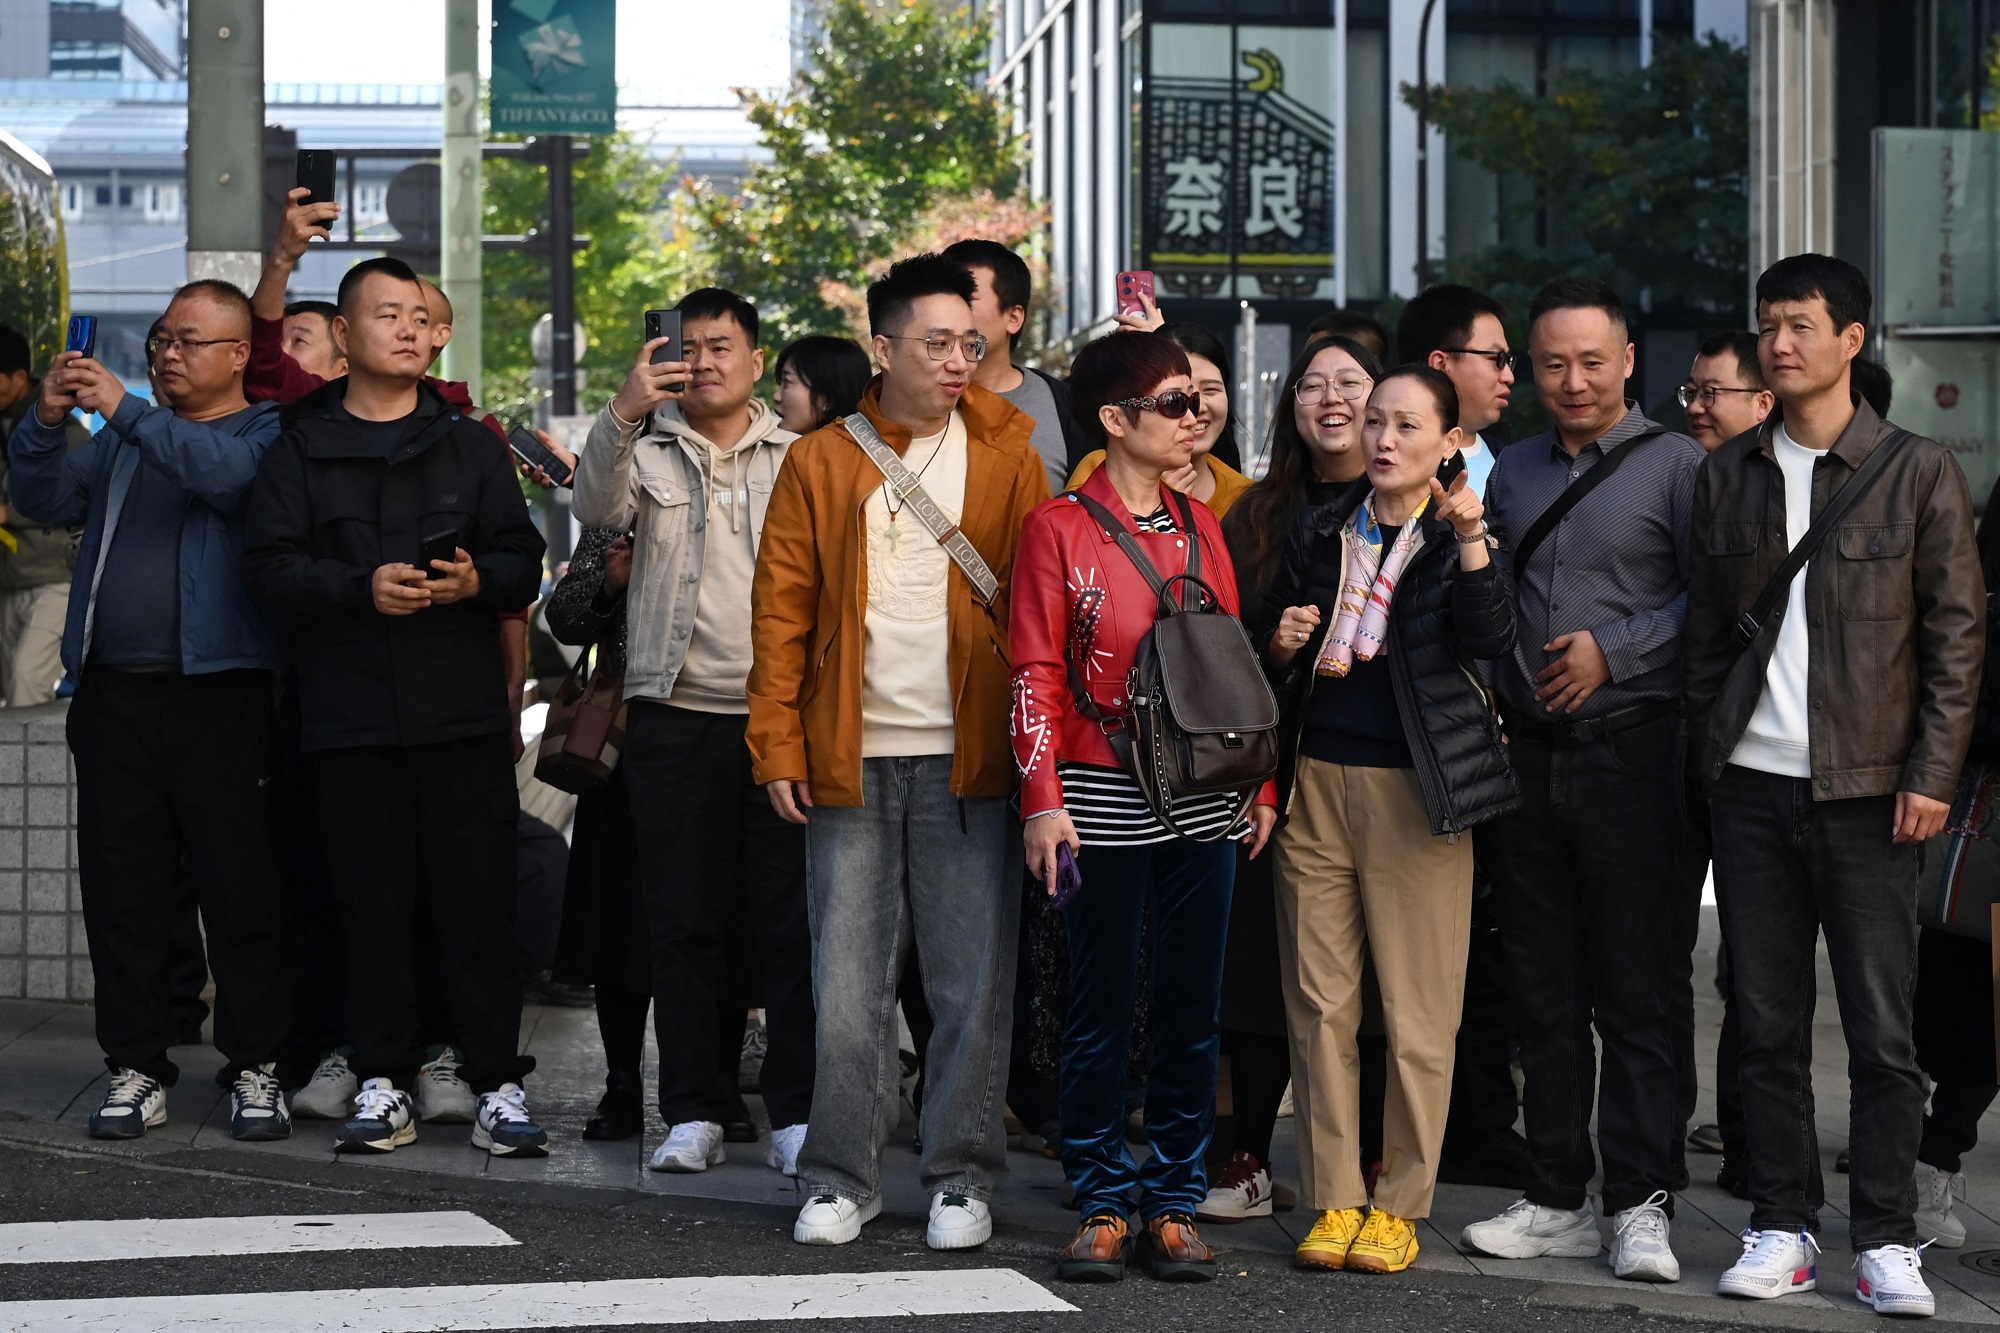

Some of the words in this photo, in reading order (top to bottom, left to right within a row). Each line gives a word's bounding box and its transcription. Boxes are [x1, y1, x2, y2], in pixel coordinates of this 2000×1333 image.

[1164, 156, 1304, 239] 奈良
[852, 420, 888, 458] LOEWE
[955, 543, 992, 587] LOEWE
